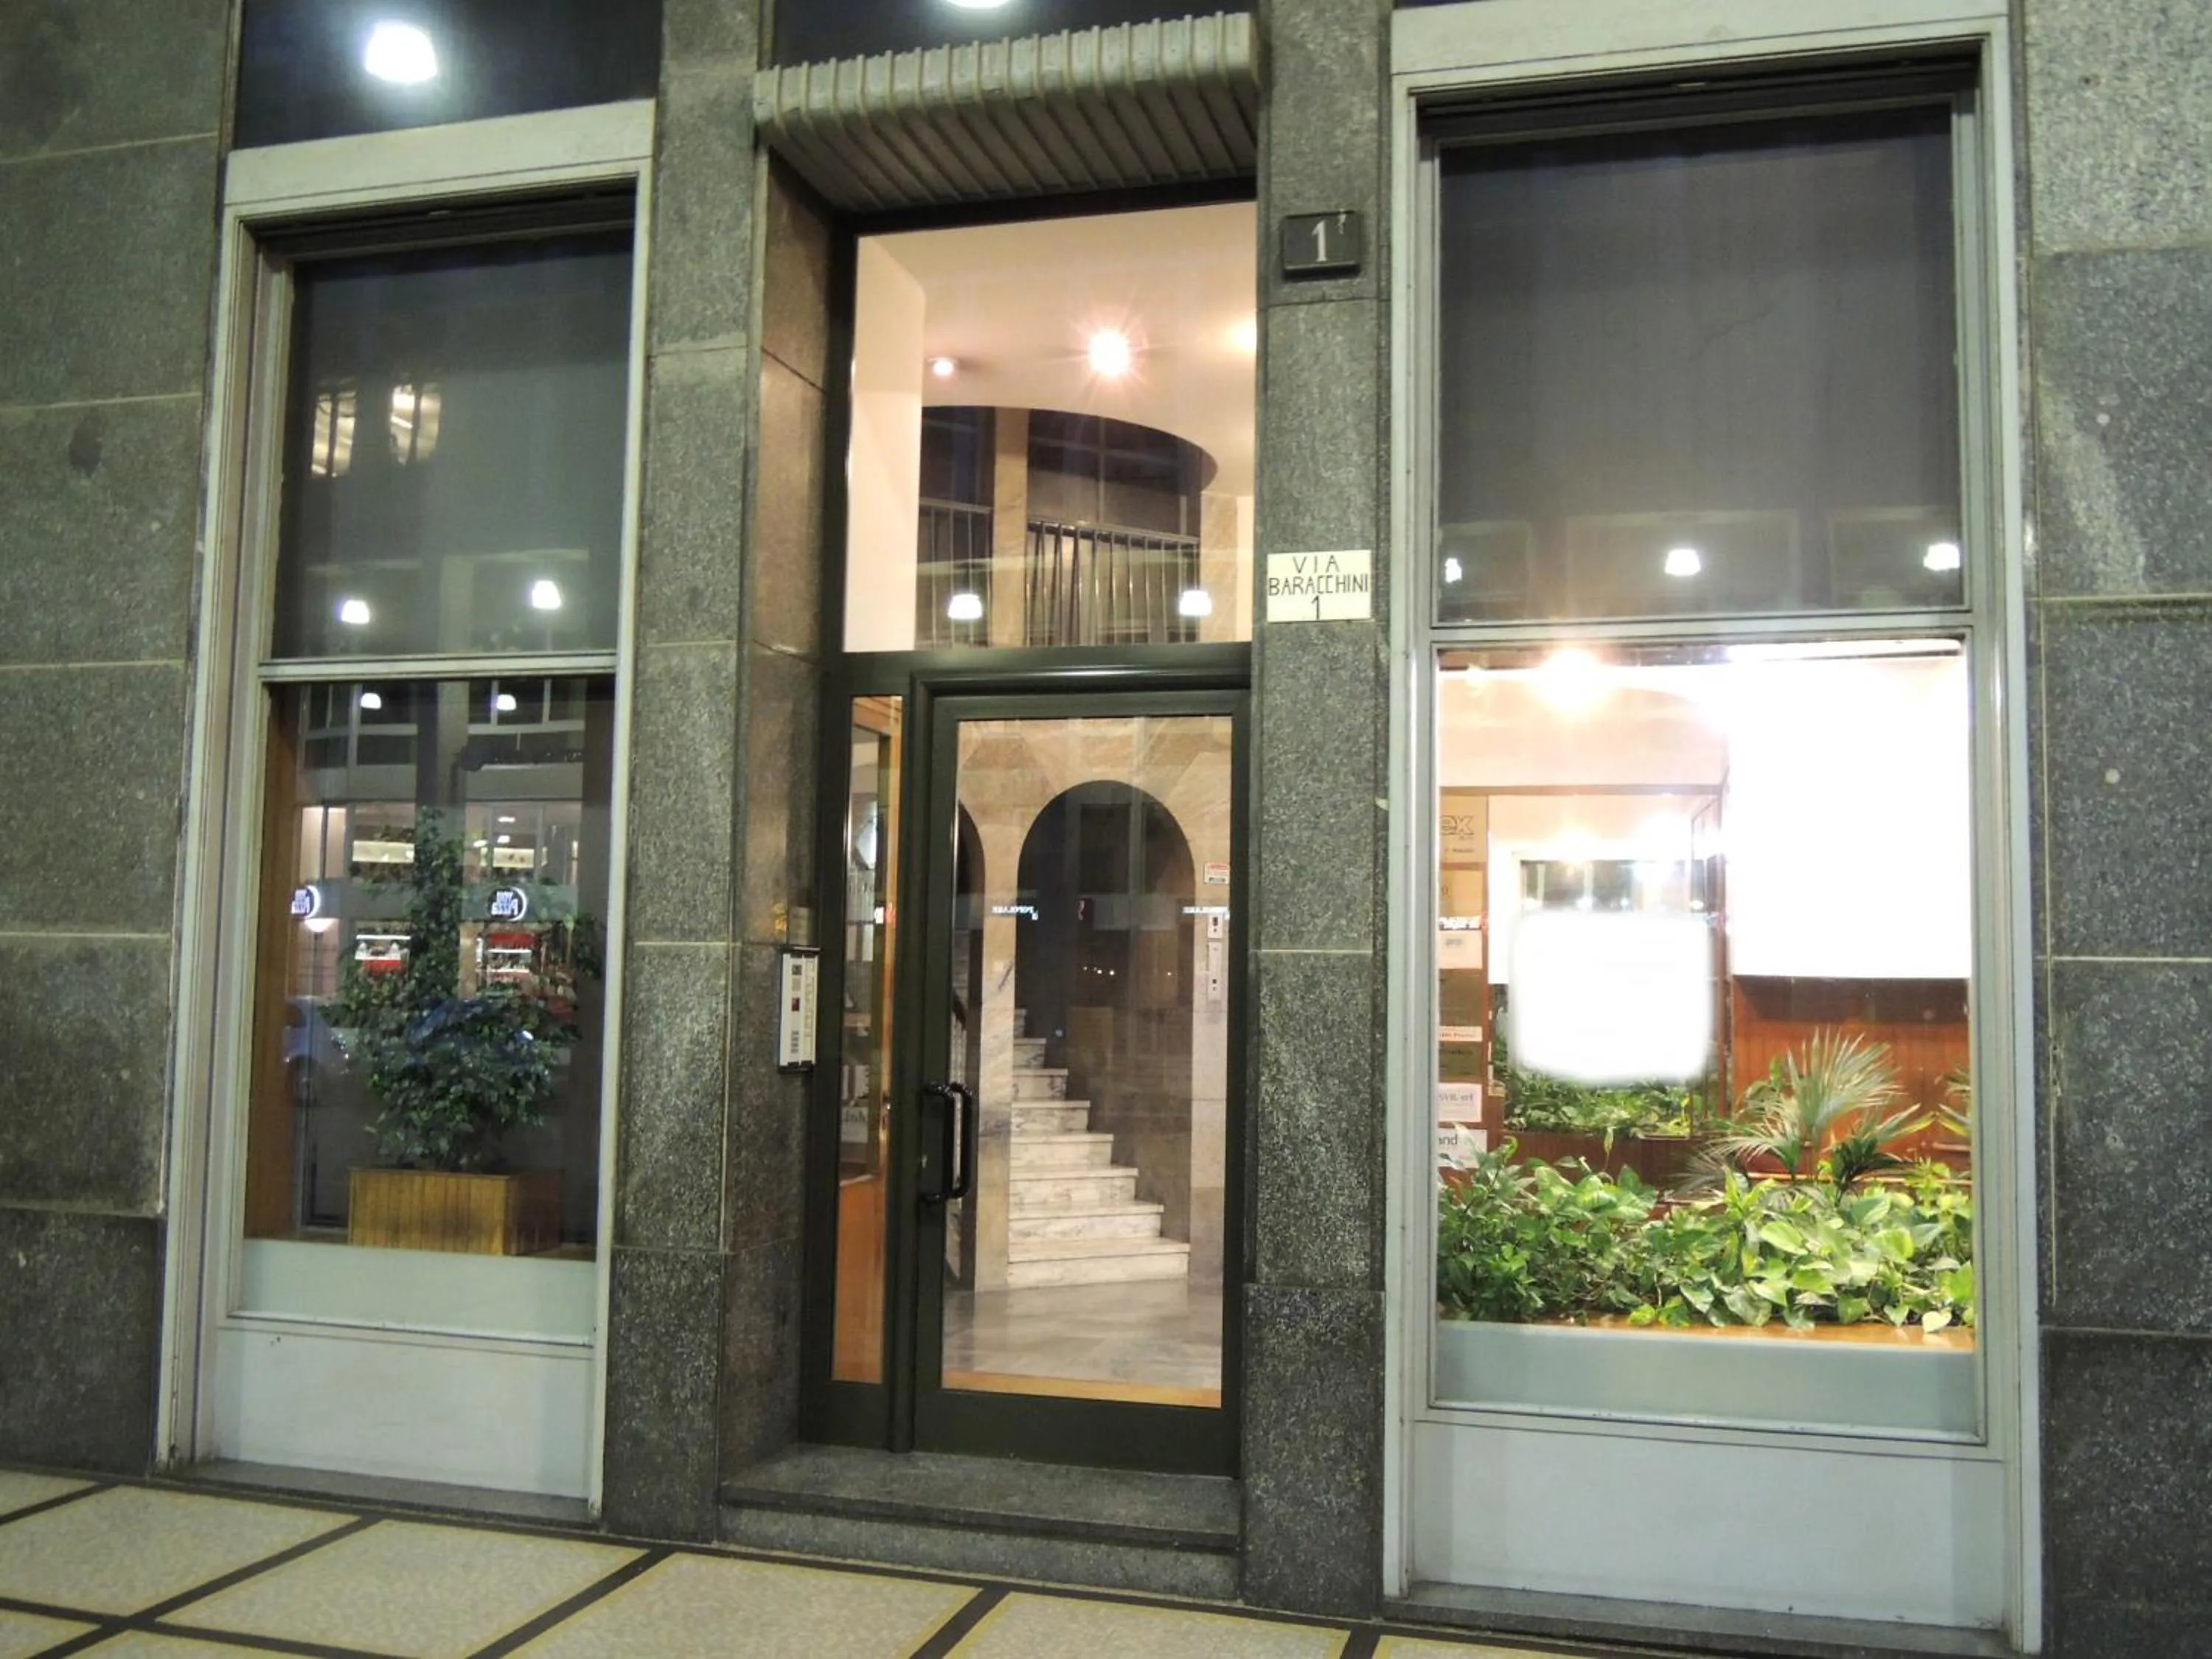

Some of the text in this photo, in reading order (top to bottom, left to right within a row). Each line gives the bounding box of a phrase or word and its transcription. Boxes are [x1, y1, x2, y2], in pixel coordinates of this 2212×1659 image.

[1292, 554, 1340, 574] VIA
[1267, 573, 1369, 597] BARACCHINI
[1311, 594, 1321, 620] 1
